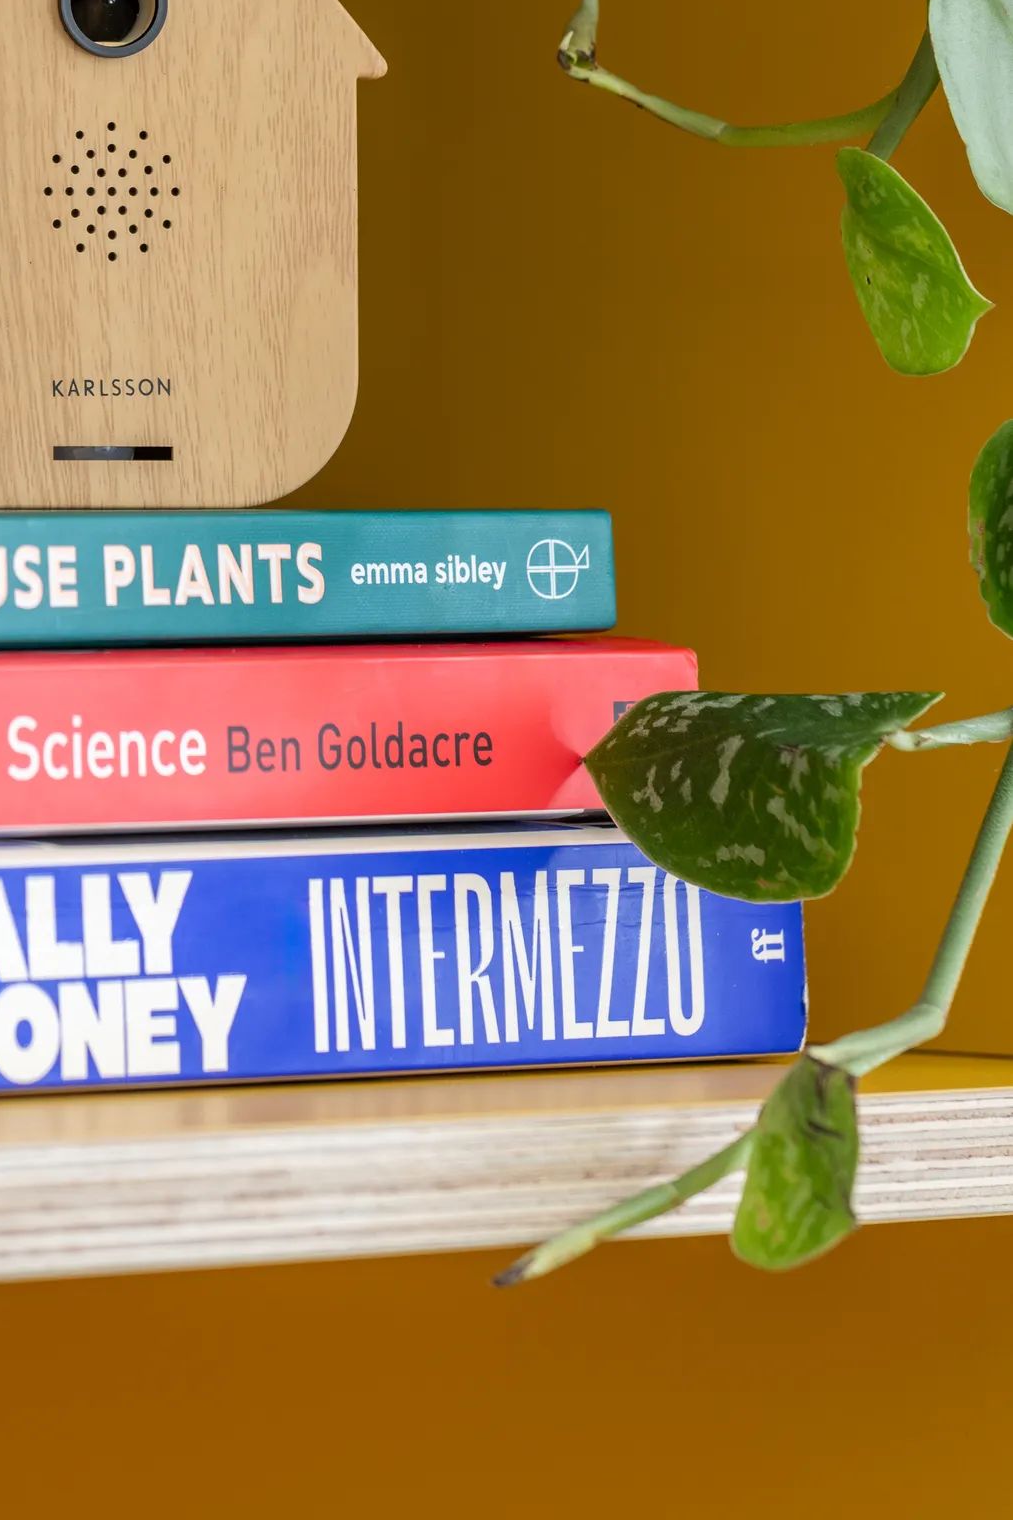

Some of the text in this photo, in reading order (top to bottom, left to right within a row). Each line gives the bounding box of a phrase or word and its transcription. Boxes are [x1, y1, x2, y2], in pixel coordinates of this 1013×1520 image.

[52, 377, 172, 397] KARLSSON
[103, 541, 326, 607] PLANTS
[350, 560, 428, 585] emma
[435, 555, 507, 591] sibley
[7, 714, 207, 781] Science
[227, 725, 301, 774] Ben
[317, 721, 494, 771] Goldacre
[308, 865, 706, 1053] INTERMEZZO
